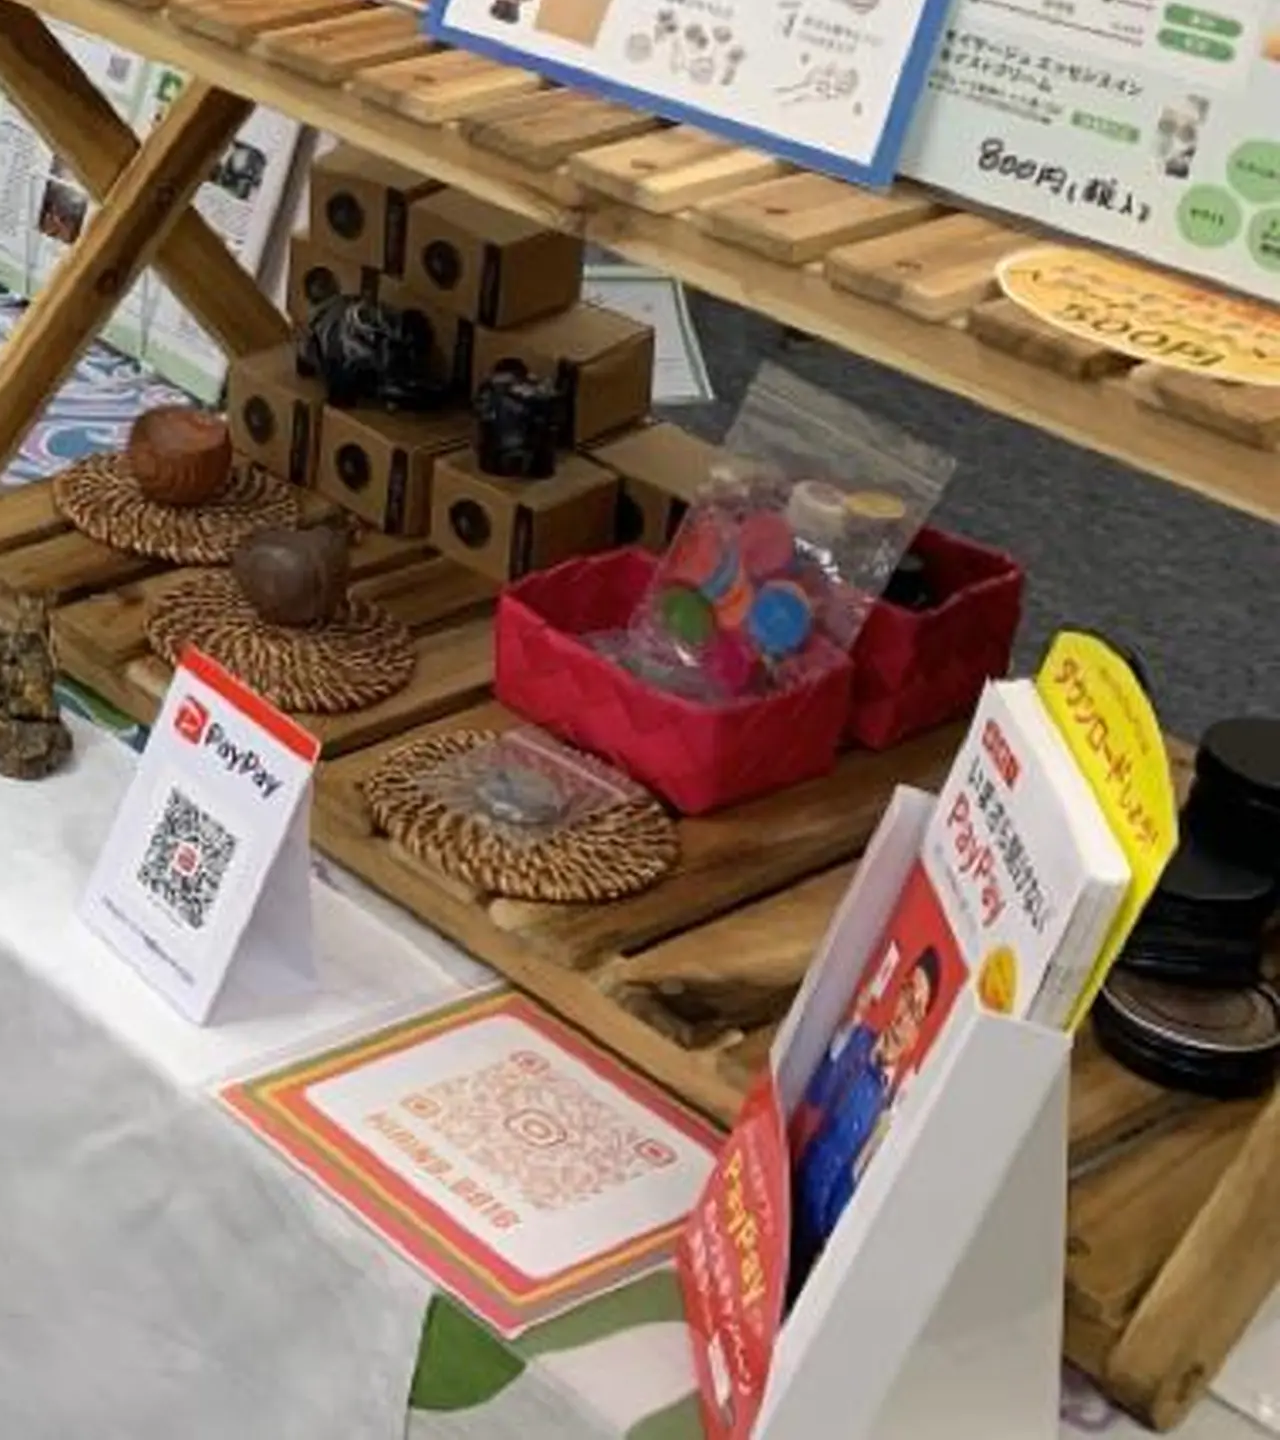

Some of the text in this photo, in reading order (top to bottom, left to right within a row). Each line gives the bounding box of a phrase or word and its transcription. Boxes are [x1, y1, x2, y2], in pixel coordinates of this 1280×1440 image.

[203, 721, 285, 800] PayPay
[946, 789, 1007, 928] PayPay
[721, 1151, 766, 1314] PayPay
